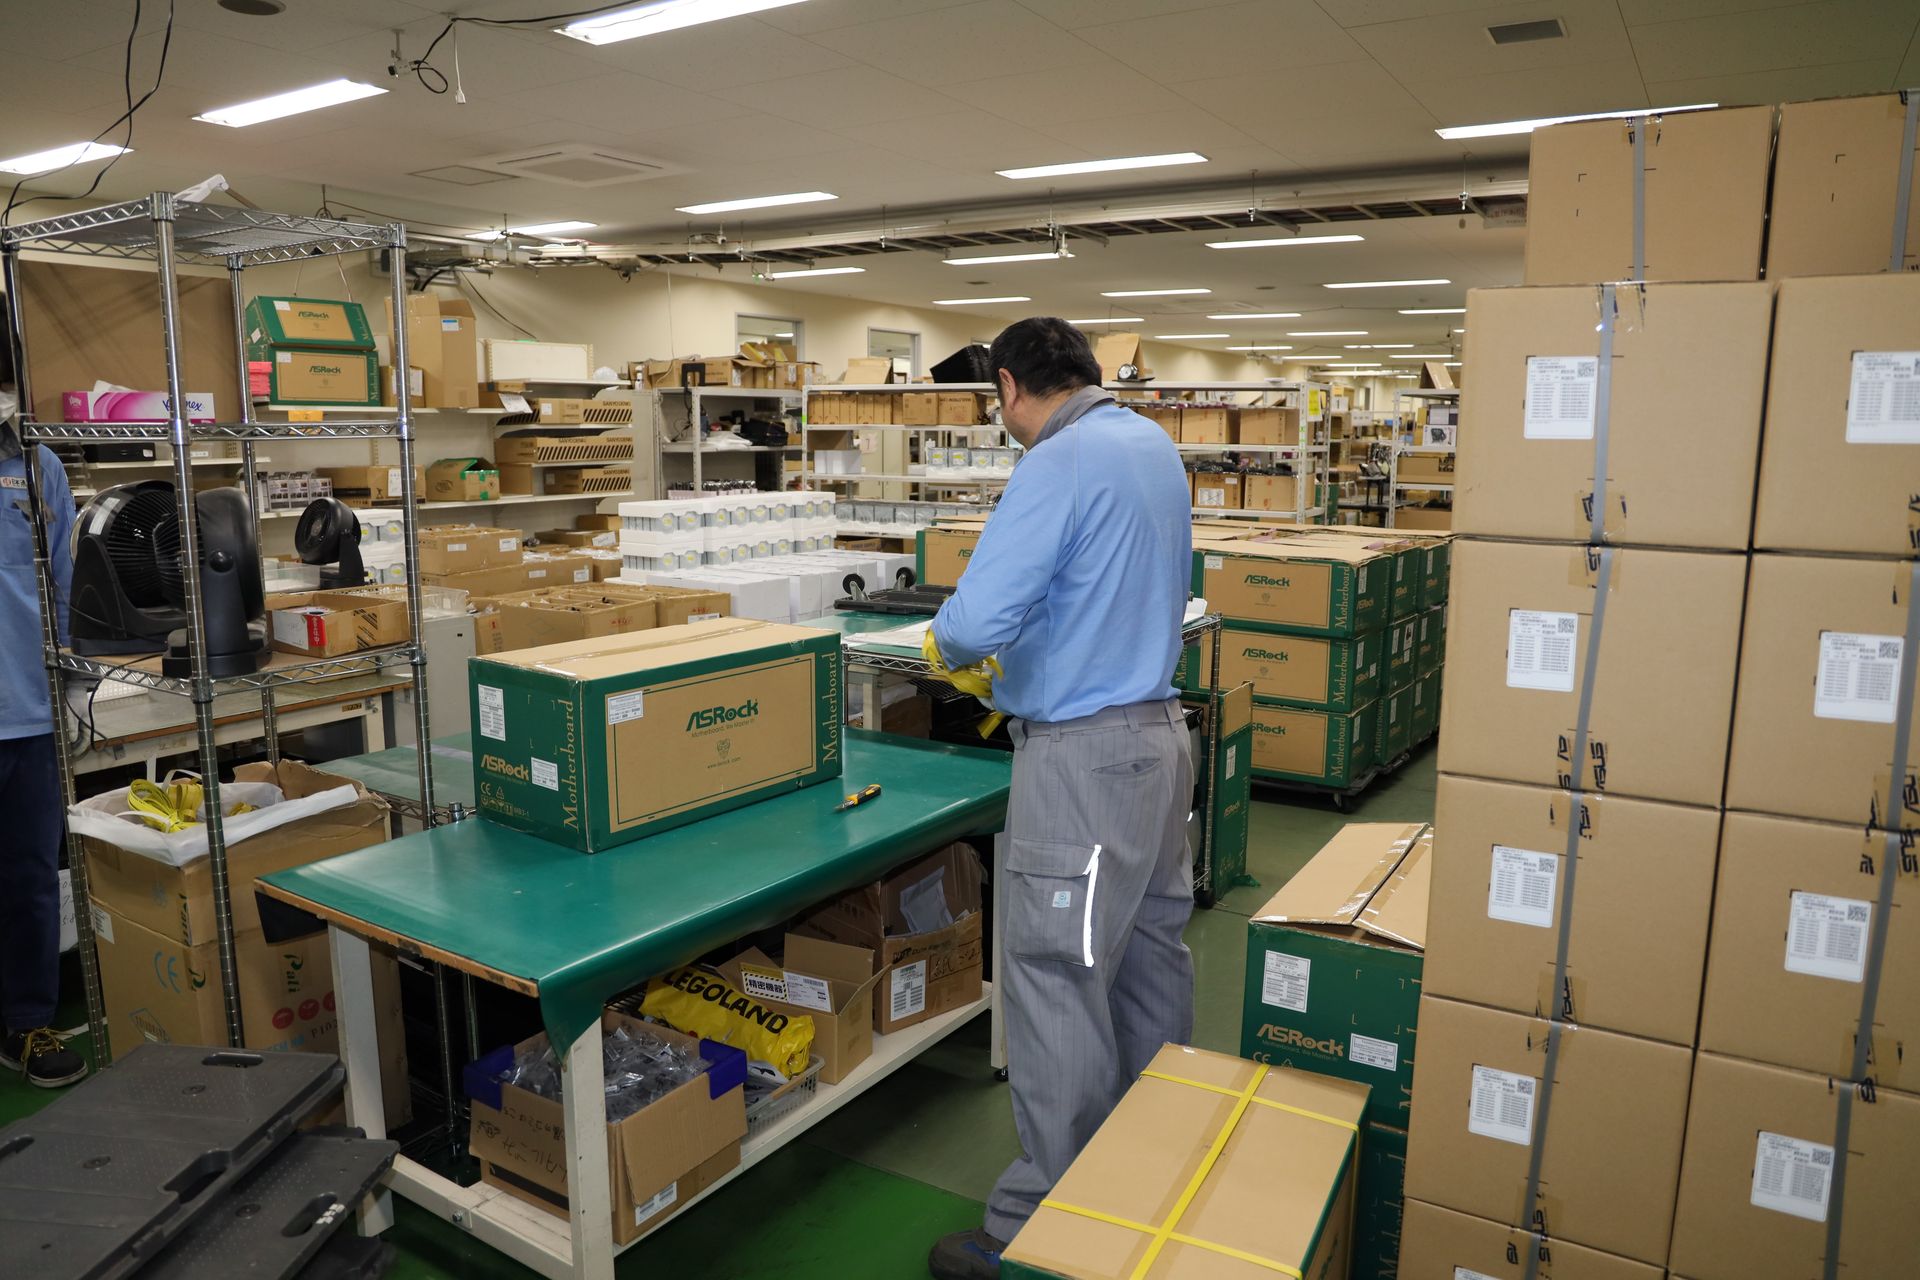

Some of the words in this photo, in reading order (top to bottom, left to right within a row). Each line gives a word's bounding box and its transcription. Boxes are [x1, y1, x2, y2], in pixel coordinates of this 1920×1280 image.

[298, 311, 330, 320] ASRock
[309, 365, 341, 375] ASRock
[162, 399, 203, 412] Knex
[1244, 574, 1290, 587] ASRock
[1334, 565, 1350, 630] Motherboard
[1242, 647, 1288, 661] ASRock
[1333, 641, 1348, 704] Motherboard
[686, 699, 759, 731] ASRock
[822, 651, 837, 765] Motherboard
[1251, 722, 1286, 735] SRock
[1331, 717, 1346, 778] Motherboard
[480, 754, 530, 781] ASRock
[557, 698, 580, 834] Motherboard
[283, 953, 304, 994] Pali
[748, 978, 784, 995] 精密機器
[661, 969, 789, 1035] LEGOLAND
[1256, 1023, 1344, 1057] ASRock
